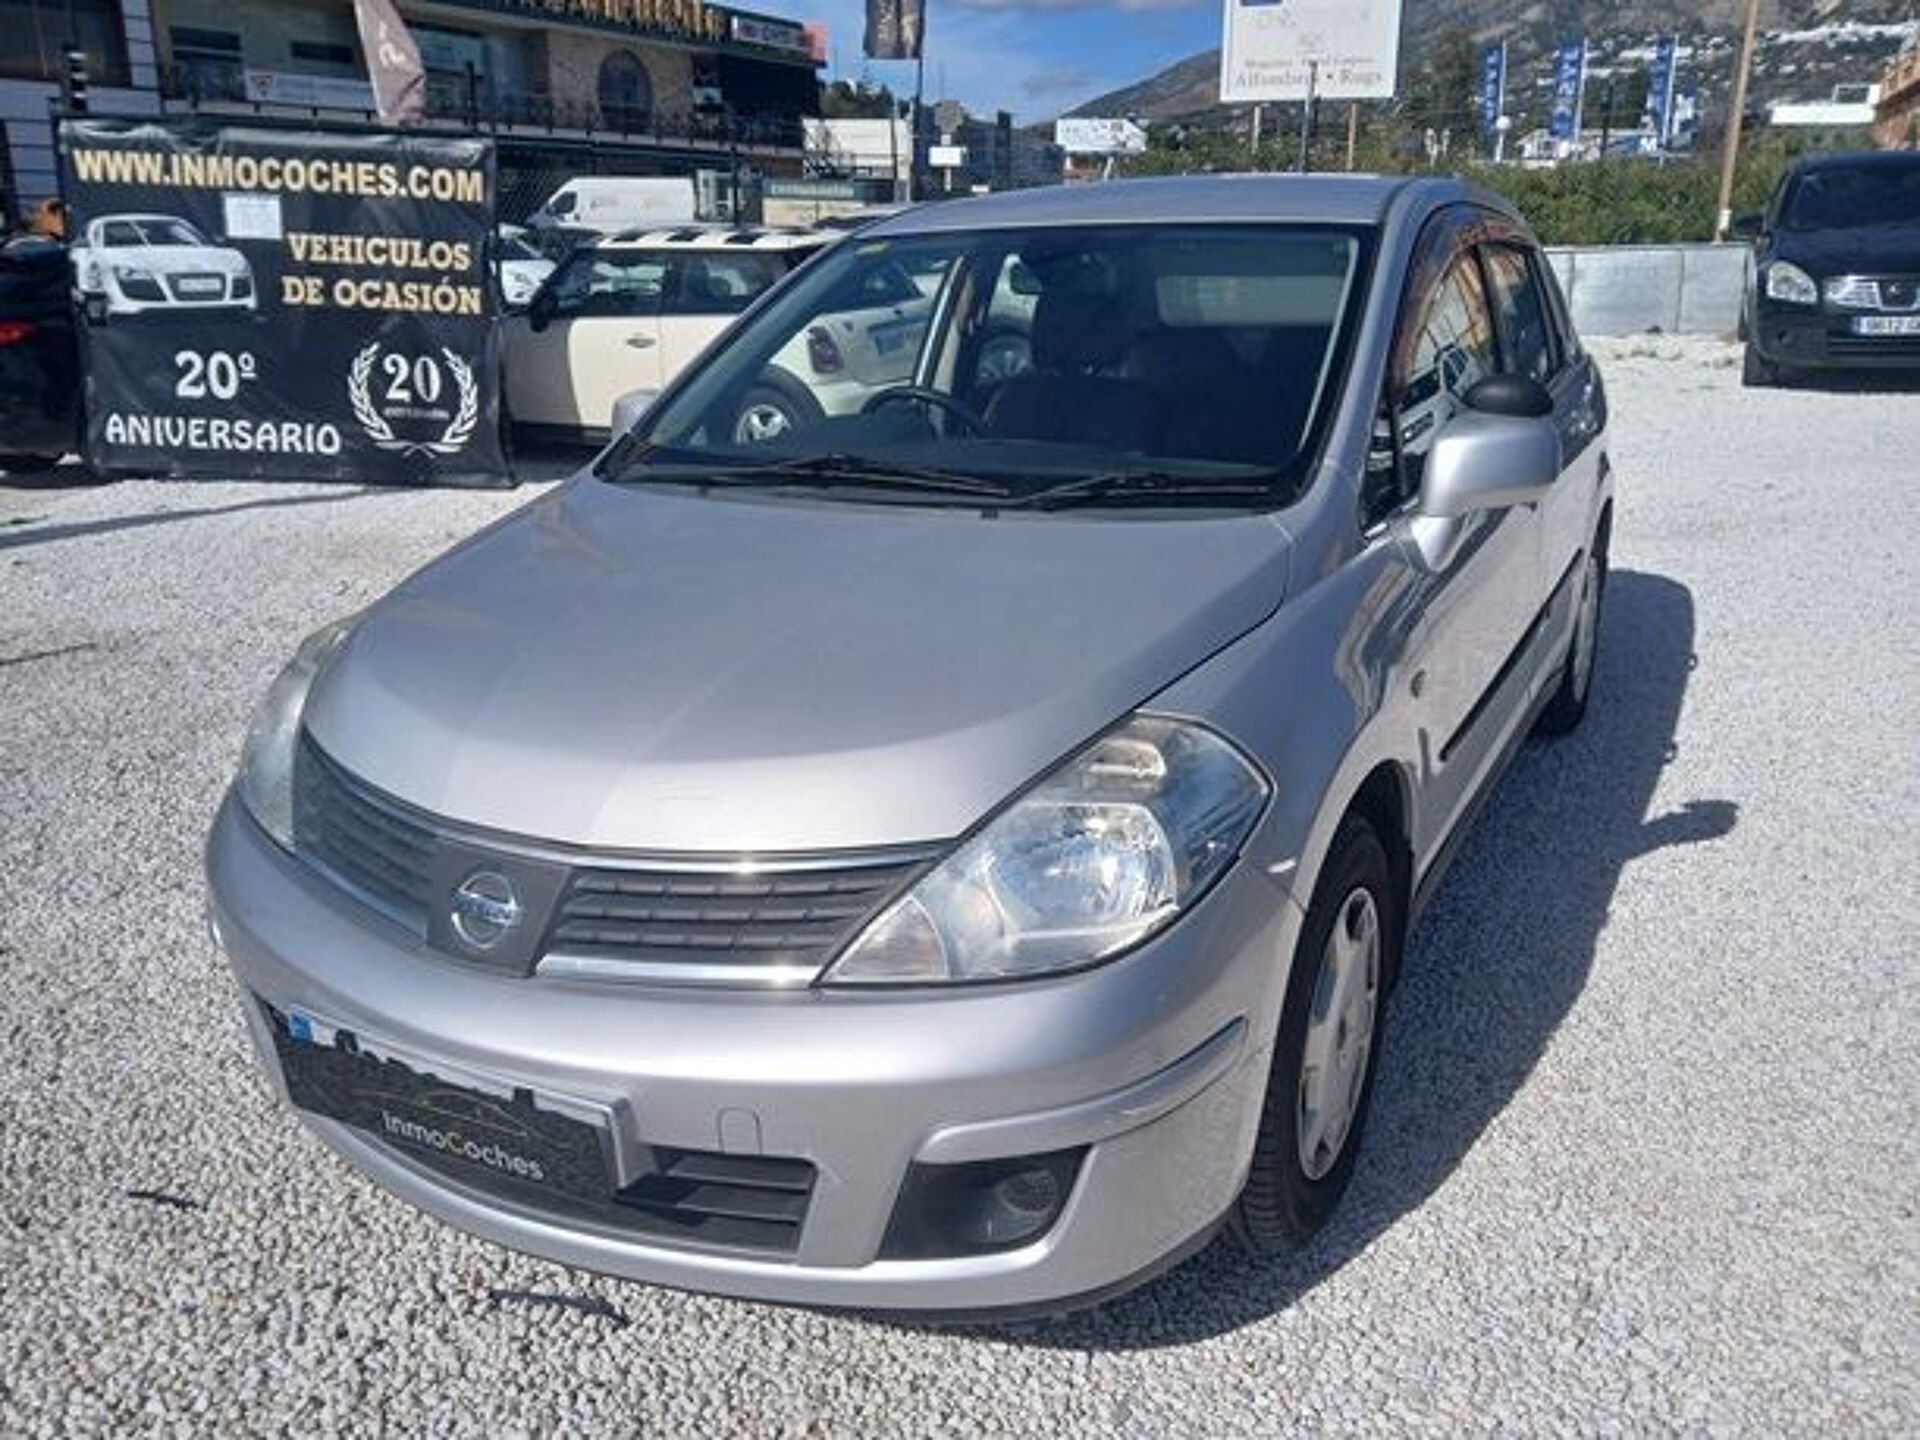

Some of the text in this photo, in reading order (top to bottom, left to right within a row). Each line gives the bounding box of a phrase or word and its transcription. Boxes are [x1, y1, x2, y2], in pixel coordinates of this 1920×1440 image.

[74, 150, 484, 201] WWW.INMOCOCHES.COM
[289, 233, 471, 270] VEHICULOS
[281, 274, 482, 315] DE OCASIÓN
[383, 352, 442, 403] 20
[106, 413, 341, 455] ANIVERSARIO
